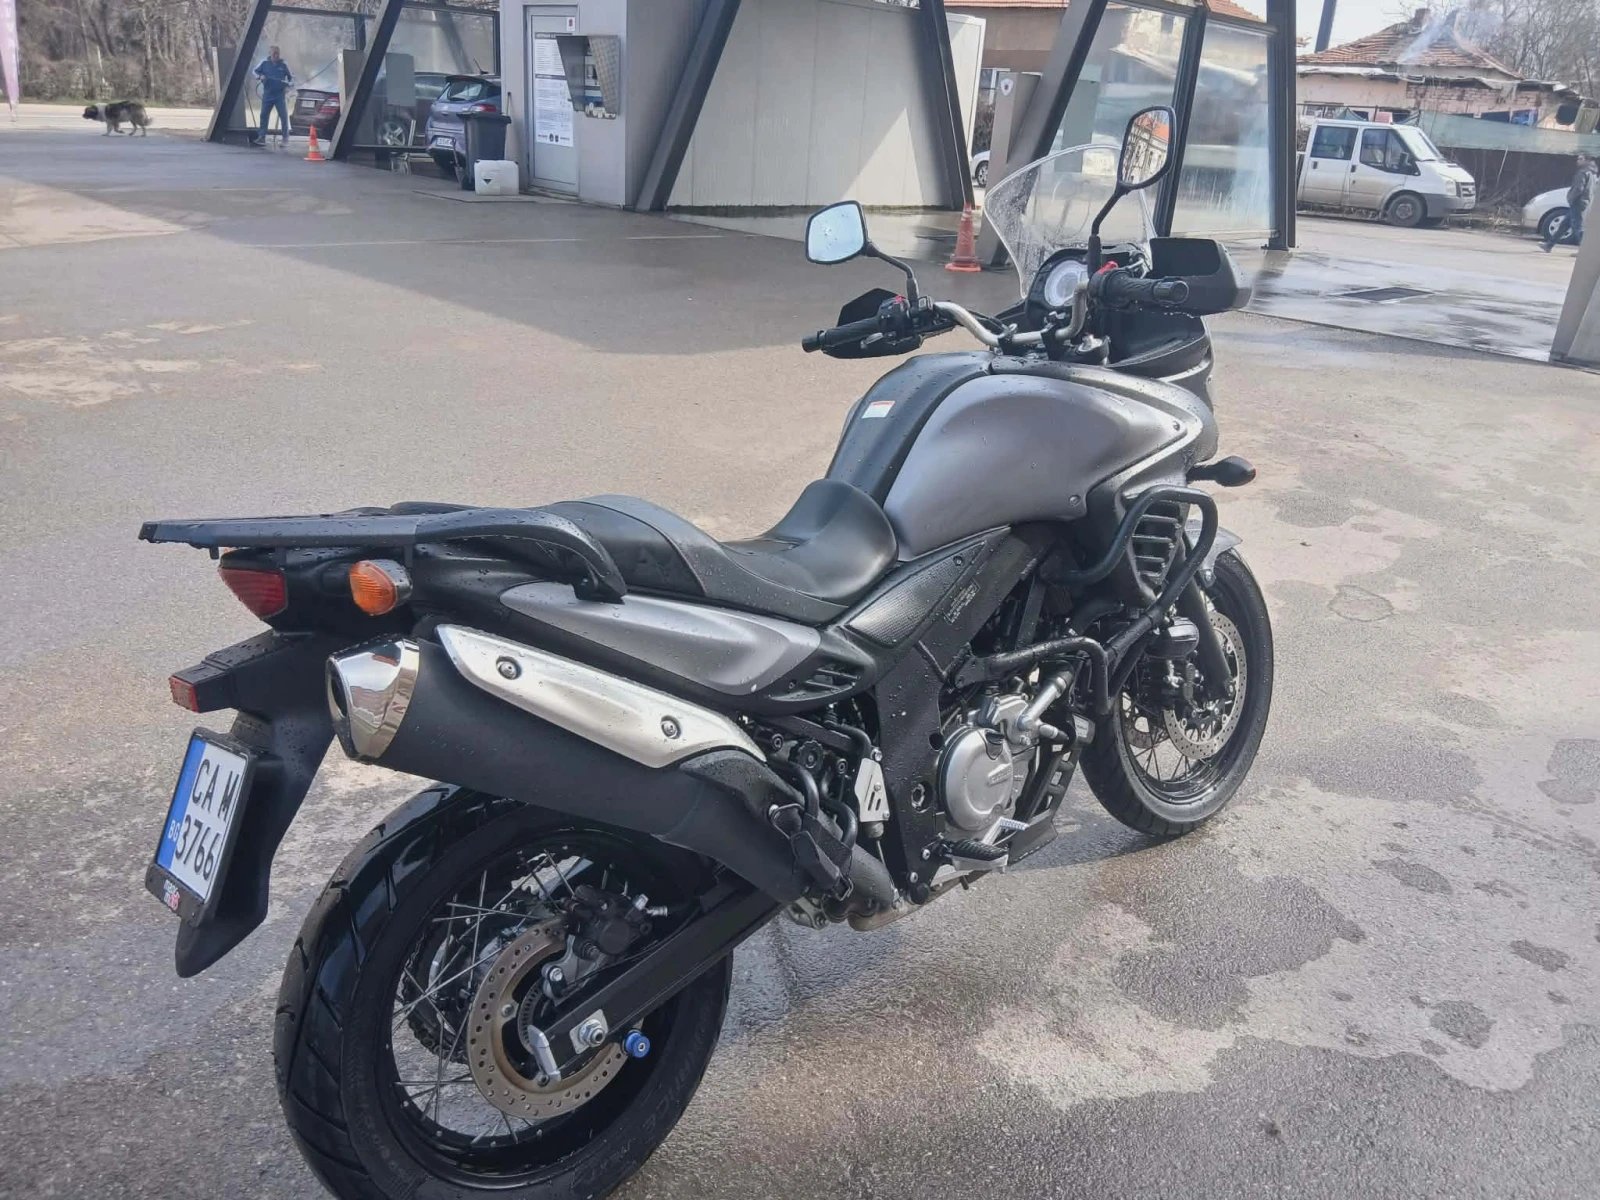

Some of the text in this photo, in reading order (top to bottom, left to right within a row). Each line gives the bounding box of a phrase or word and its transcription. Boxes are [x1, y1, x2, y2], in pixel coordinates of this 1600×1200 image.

[192, 759, 240, 822] CA M
[168, 820, 181, 842] BG
[175, 814, 220, 881] 3766
